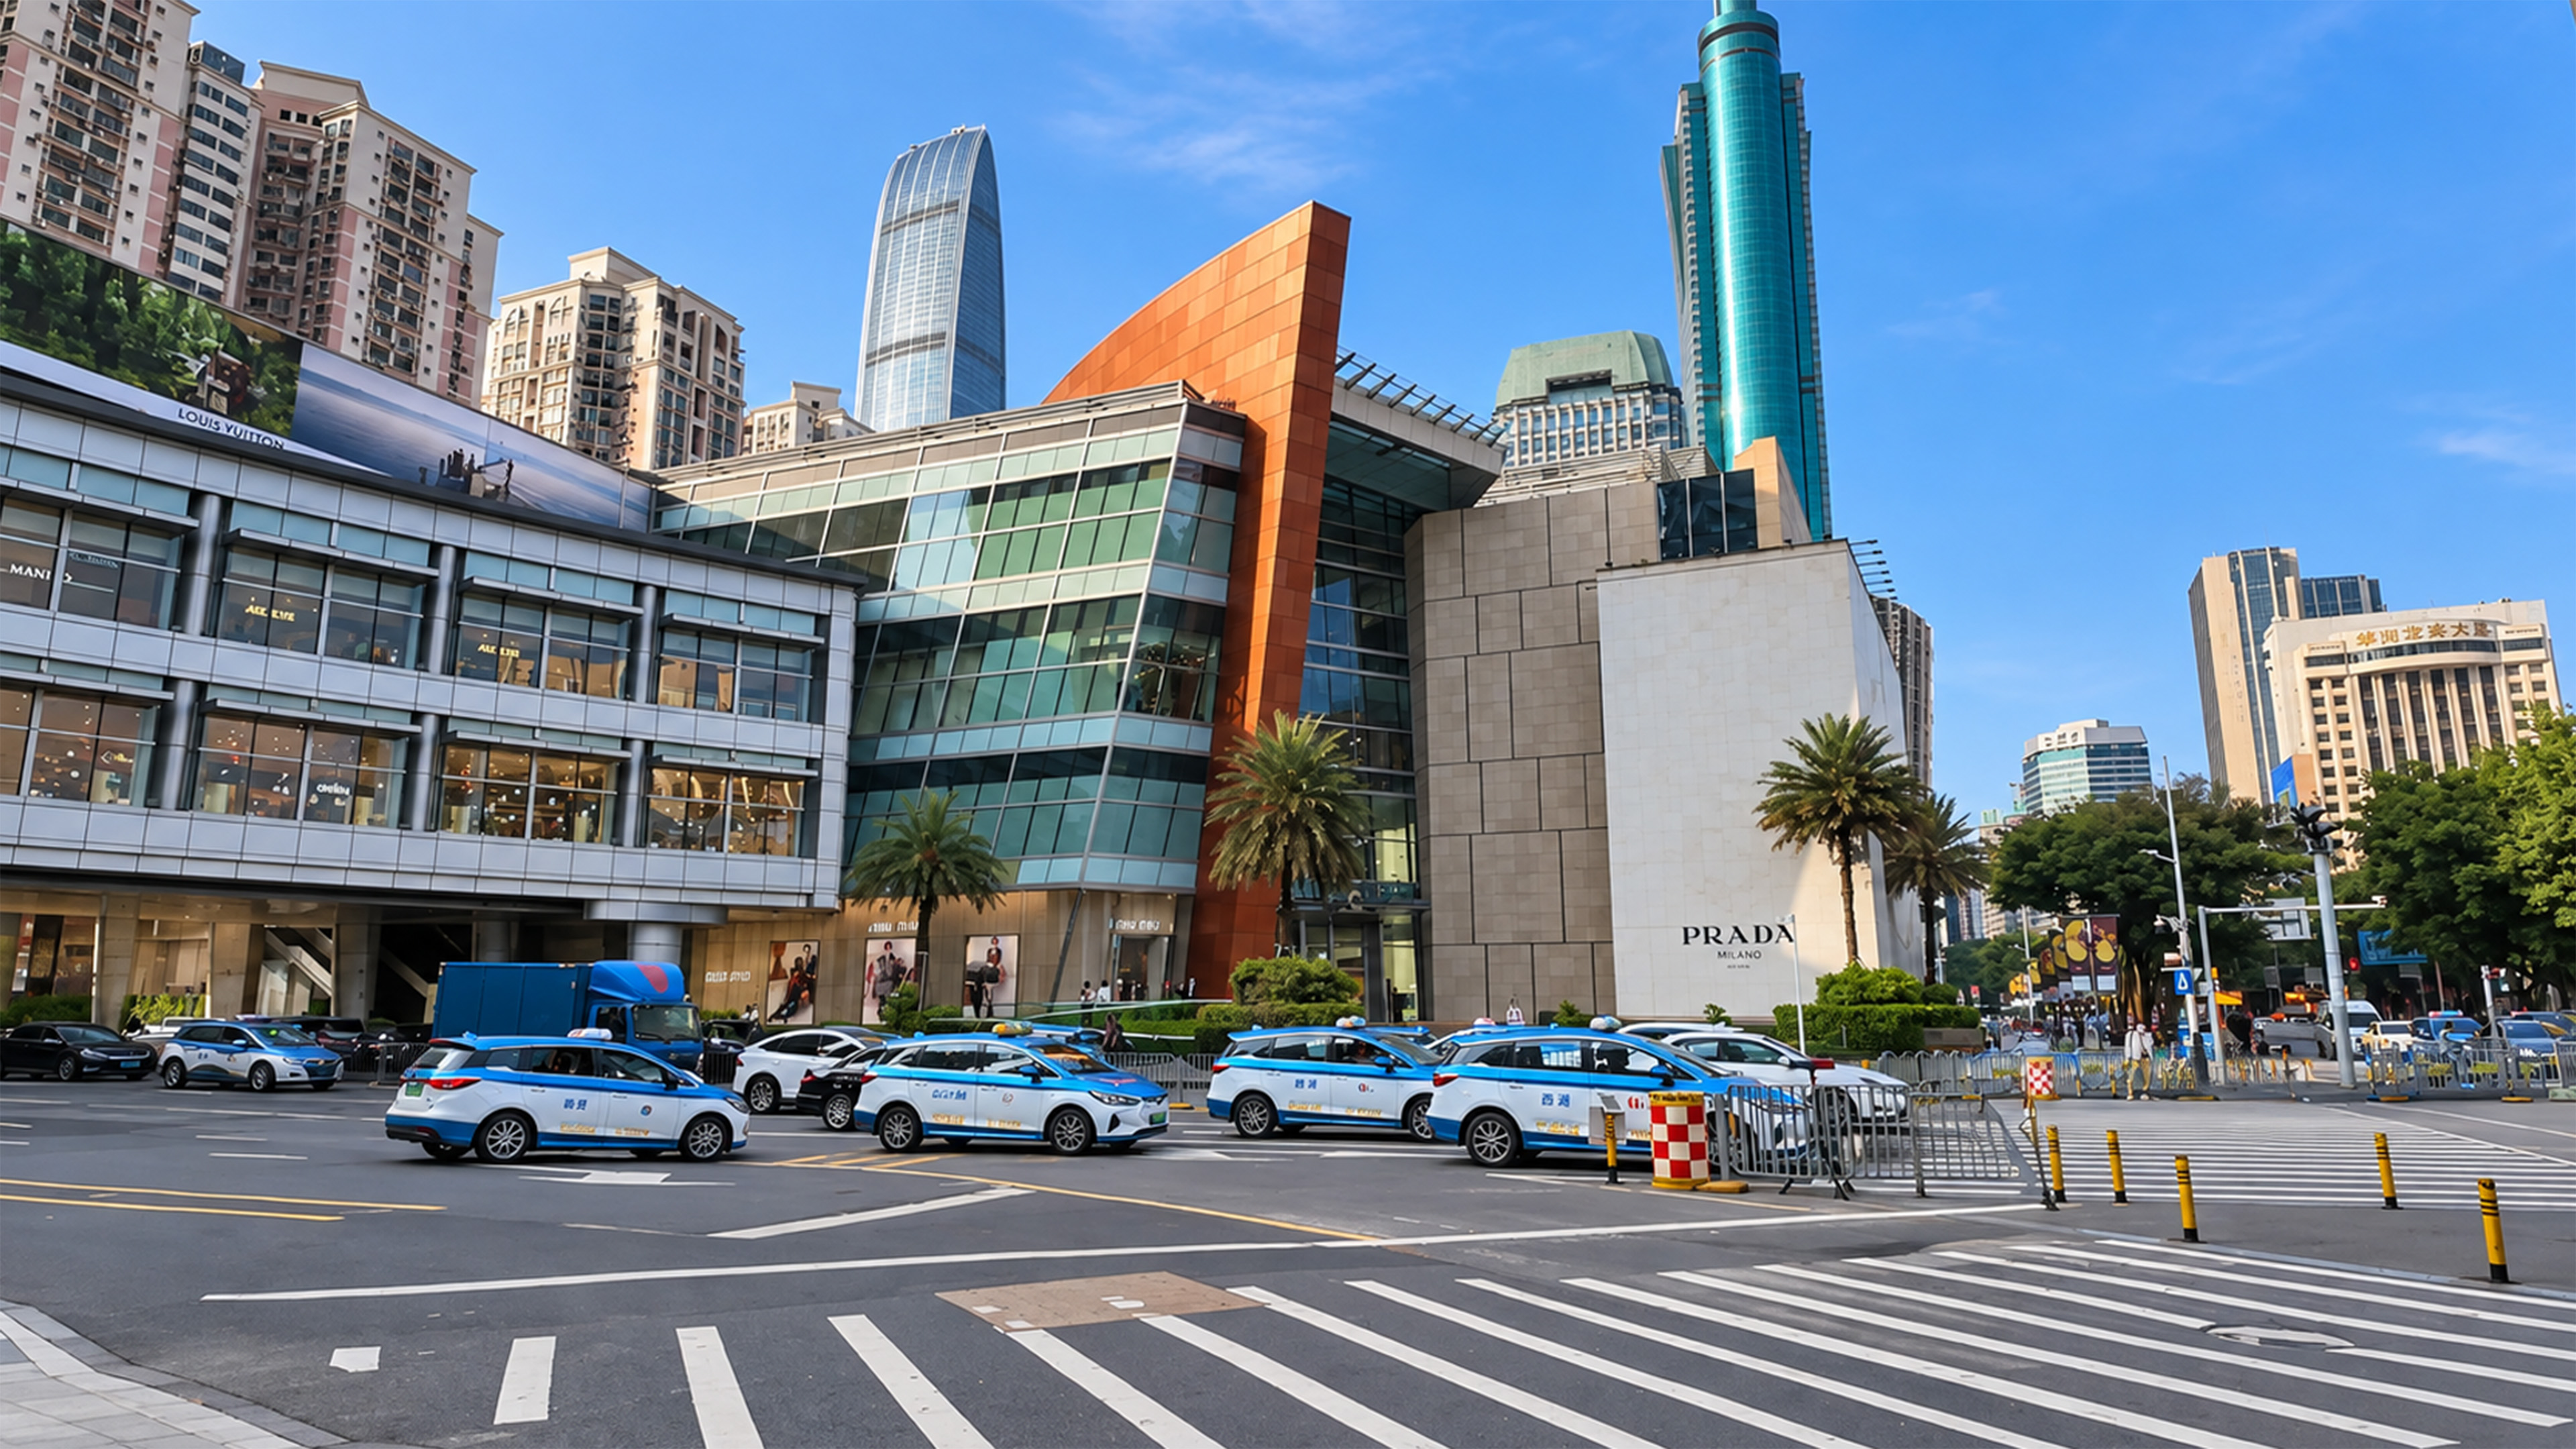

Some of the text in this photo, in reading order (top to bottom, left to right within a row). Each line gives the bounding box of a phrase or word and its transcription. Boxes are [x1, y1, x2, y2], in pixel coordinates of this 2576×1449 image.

[178, 408, 221, 431] LOUIS
[1682, 923, 1794, 945] PRADA
[1717, 950, 1762, 960] MILANO
